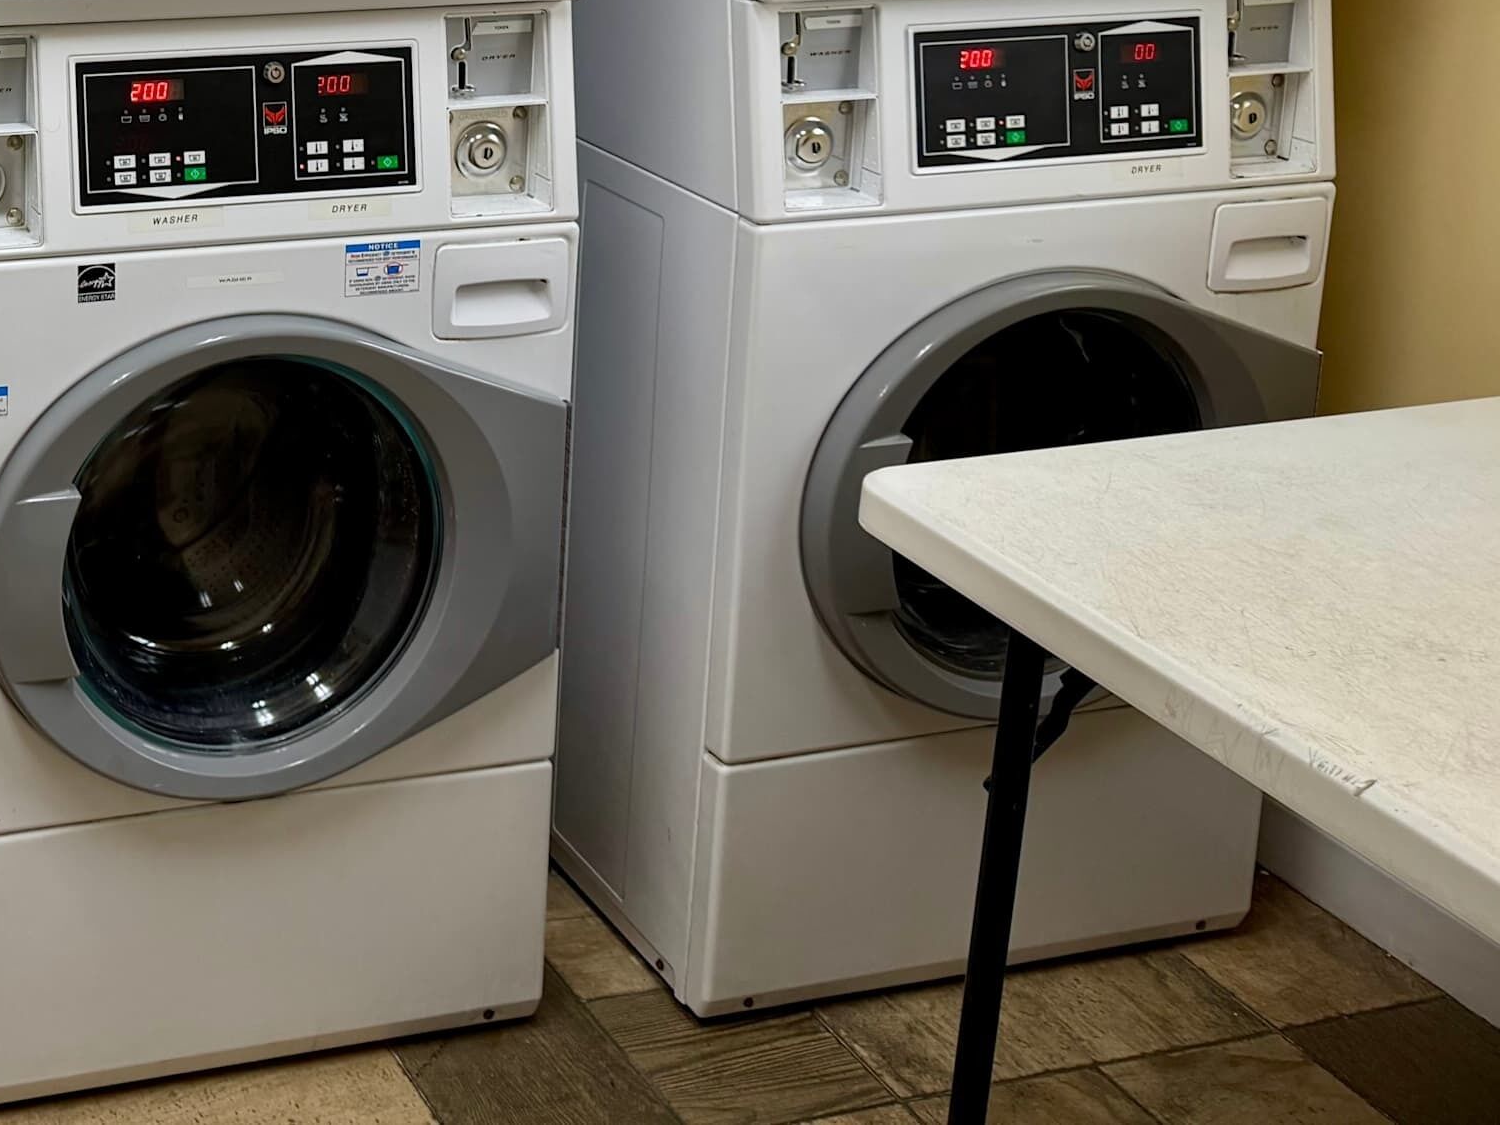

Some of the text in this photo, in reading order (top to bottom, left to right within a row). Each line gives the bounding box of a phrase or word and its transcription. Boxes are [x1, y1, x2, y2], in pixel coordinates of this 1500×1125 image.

[130, 81, 168, 102] 200
[263, 126, 288, 135] IPSO
[1131, 164, 1162, 175] DRYER
[332, 203, 368, 213] DRYER
[153, 214, 198, 225] WASHER
[368, 242, 399, 251] NOTICE
